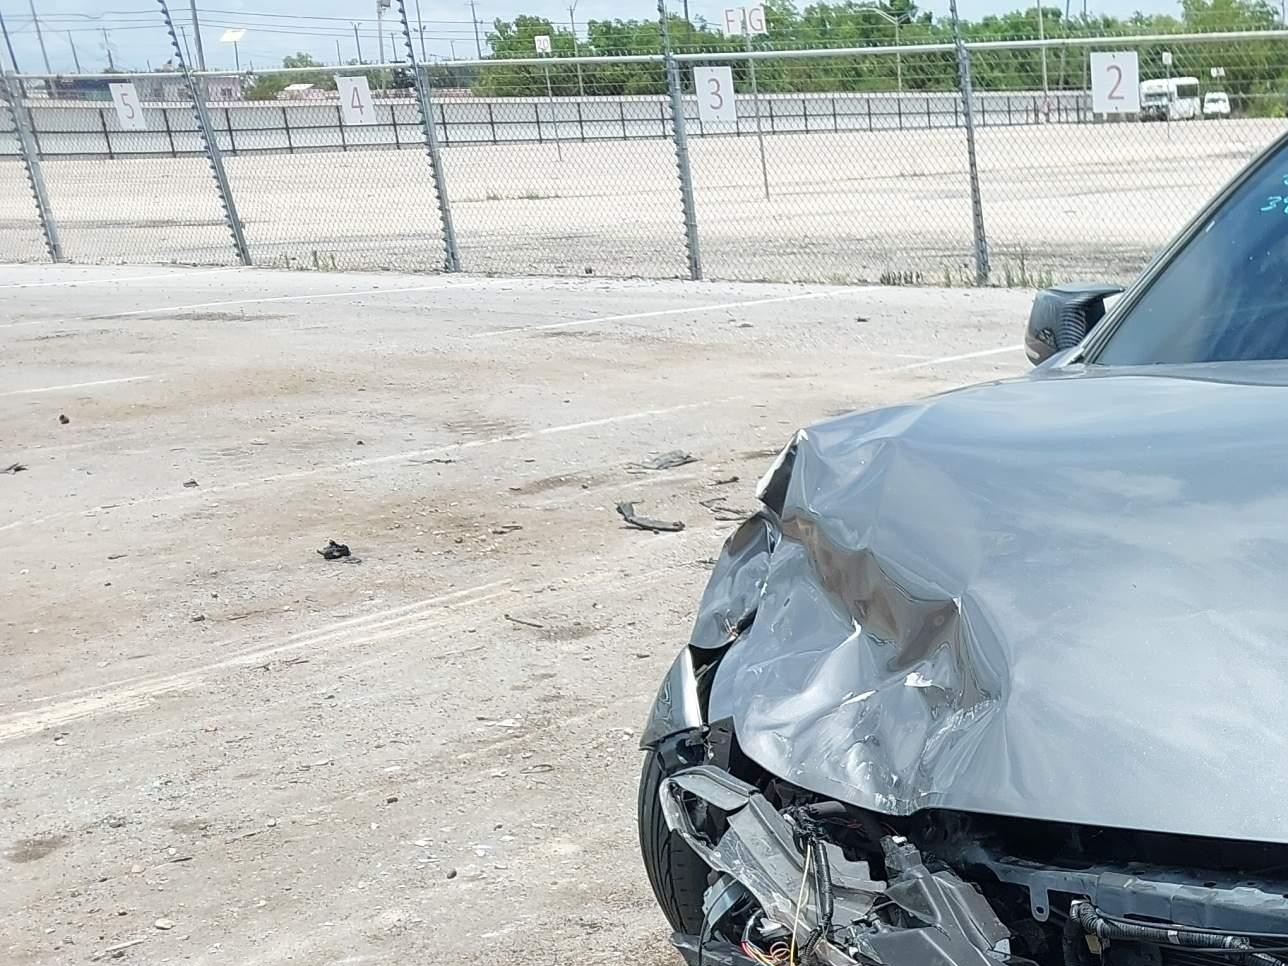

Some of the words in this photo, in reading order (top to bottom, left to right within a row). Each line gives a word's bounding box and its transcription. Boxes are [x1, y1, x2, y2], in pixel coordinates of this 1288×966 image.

[707, 77, 723, 110] 3
[1106, 65, 1124, 100] 2
[120, 92, 135, 119] 5
[351, 86, 364, 115] 4
